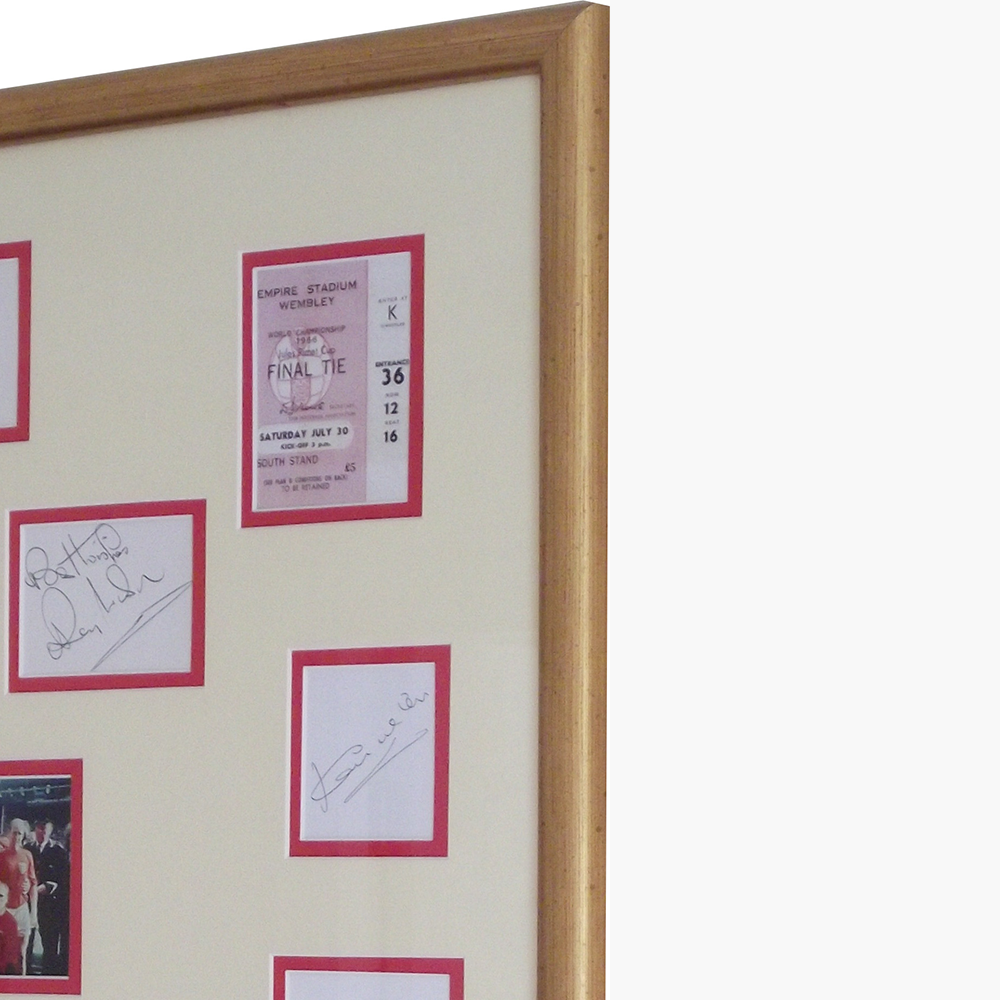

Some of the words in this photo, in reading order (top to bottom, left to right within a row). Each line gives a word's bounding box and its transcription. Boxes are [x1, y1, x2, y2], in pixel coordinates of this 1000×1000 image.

[257, 286, 298, 299] EMPIRE
[307, 280, 357, 294] STADIUM
[279, 297, 335, 310] WEMBLEY
[388, 304, 397, 320] K
[295, 325, 346, 336] CHAMPIONSHIP
[296, 336, 318, 344] 1966
[268, 361, 312, 380] FINAL
[322, 358, 346, 375] TIE
[381, 367, 404, 386] 36
[384, 402, 398, 415] 12
[260, 430, 307, 442] SATURDAY
[311, 428, 332, 438] JULY
[337, 426, 349, 436] 30
[384, 430, 398, 443] 16
[257, 456, 285, 468] SOUTH
[289, 455, 319, 466] STAND
[344, 462, 356, 472] £5
